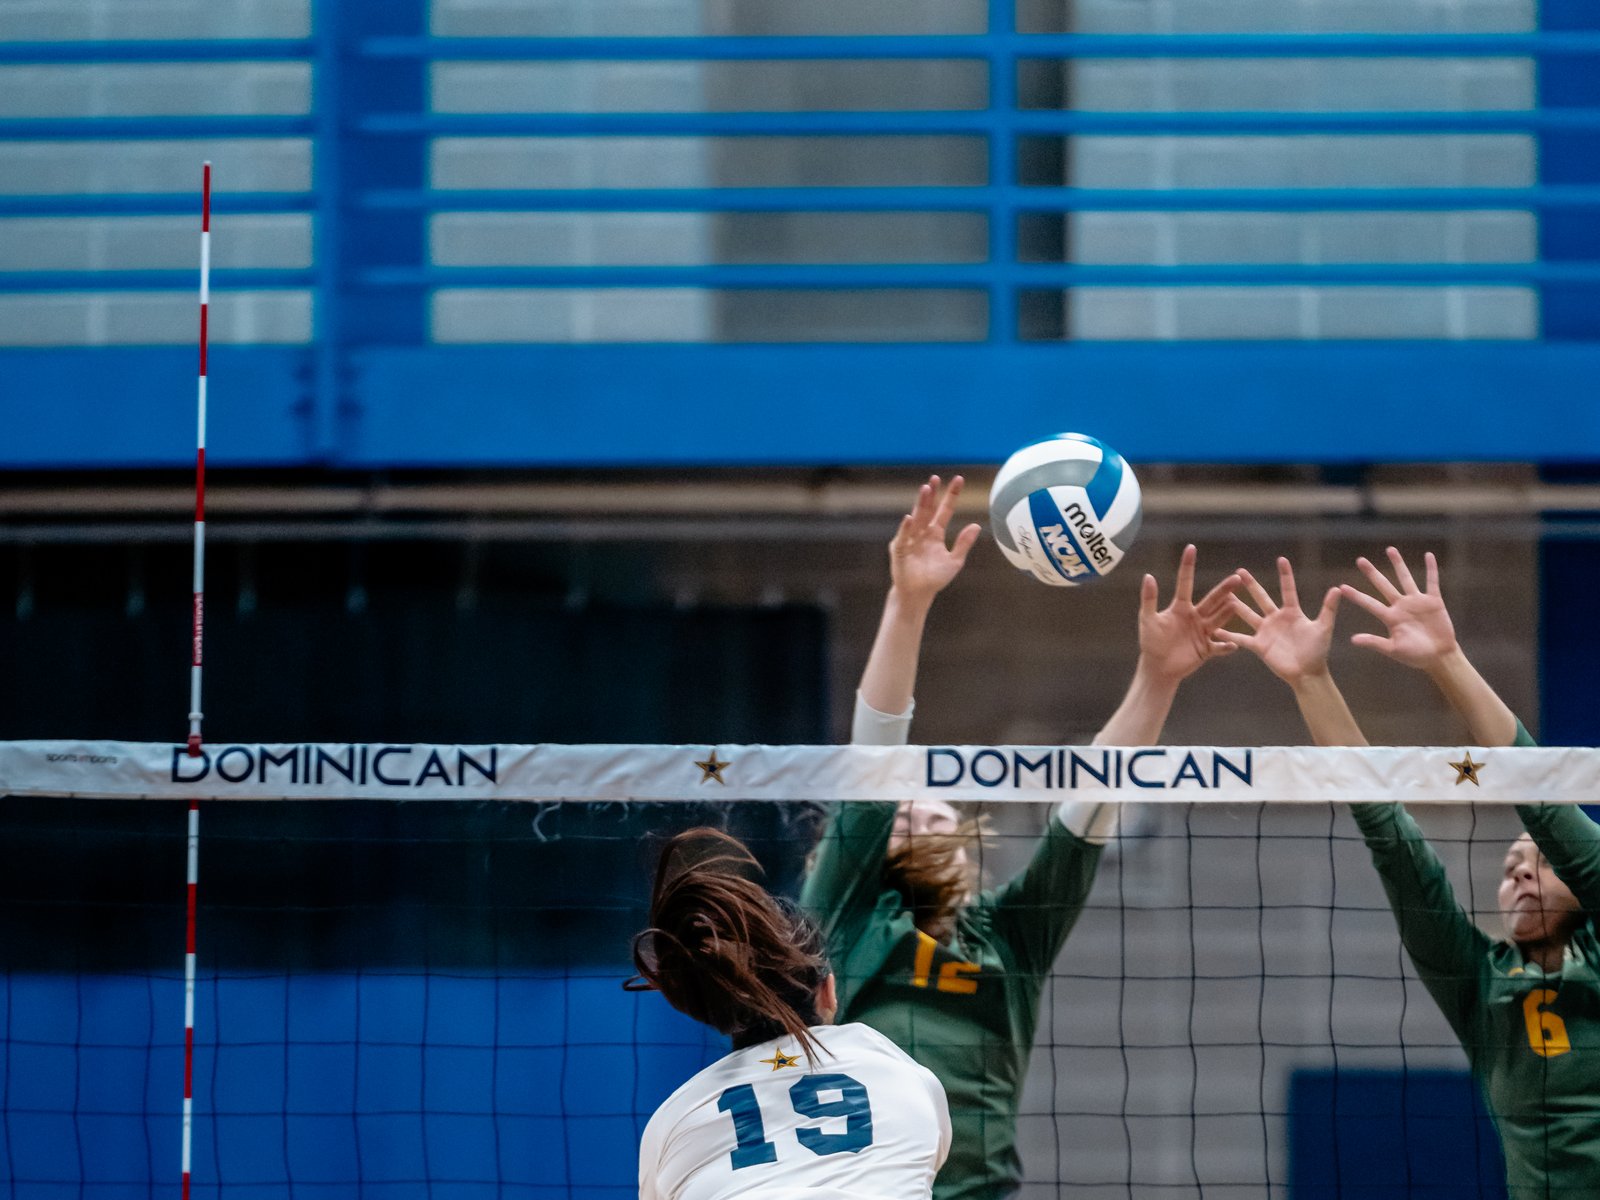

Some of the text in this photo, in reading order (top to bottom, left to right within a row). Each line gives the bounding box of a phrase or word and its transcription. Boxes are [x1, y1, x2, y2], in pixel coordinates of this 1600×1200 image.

[1039, 523, 1092, 578] NCAA
[1064, 502, 1114, 569] molten
[171, 745, 498, 786] DOMINICAN
[926, 749, 1254, 789] DOMINICAN
[1523, 989, 1571, 1057] 6
[717, 1073, 873, 1170] 19
